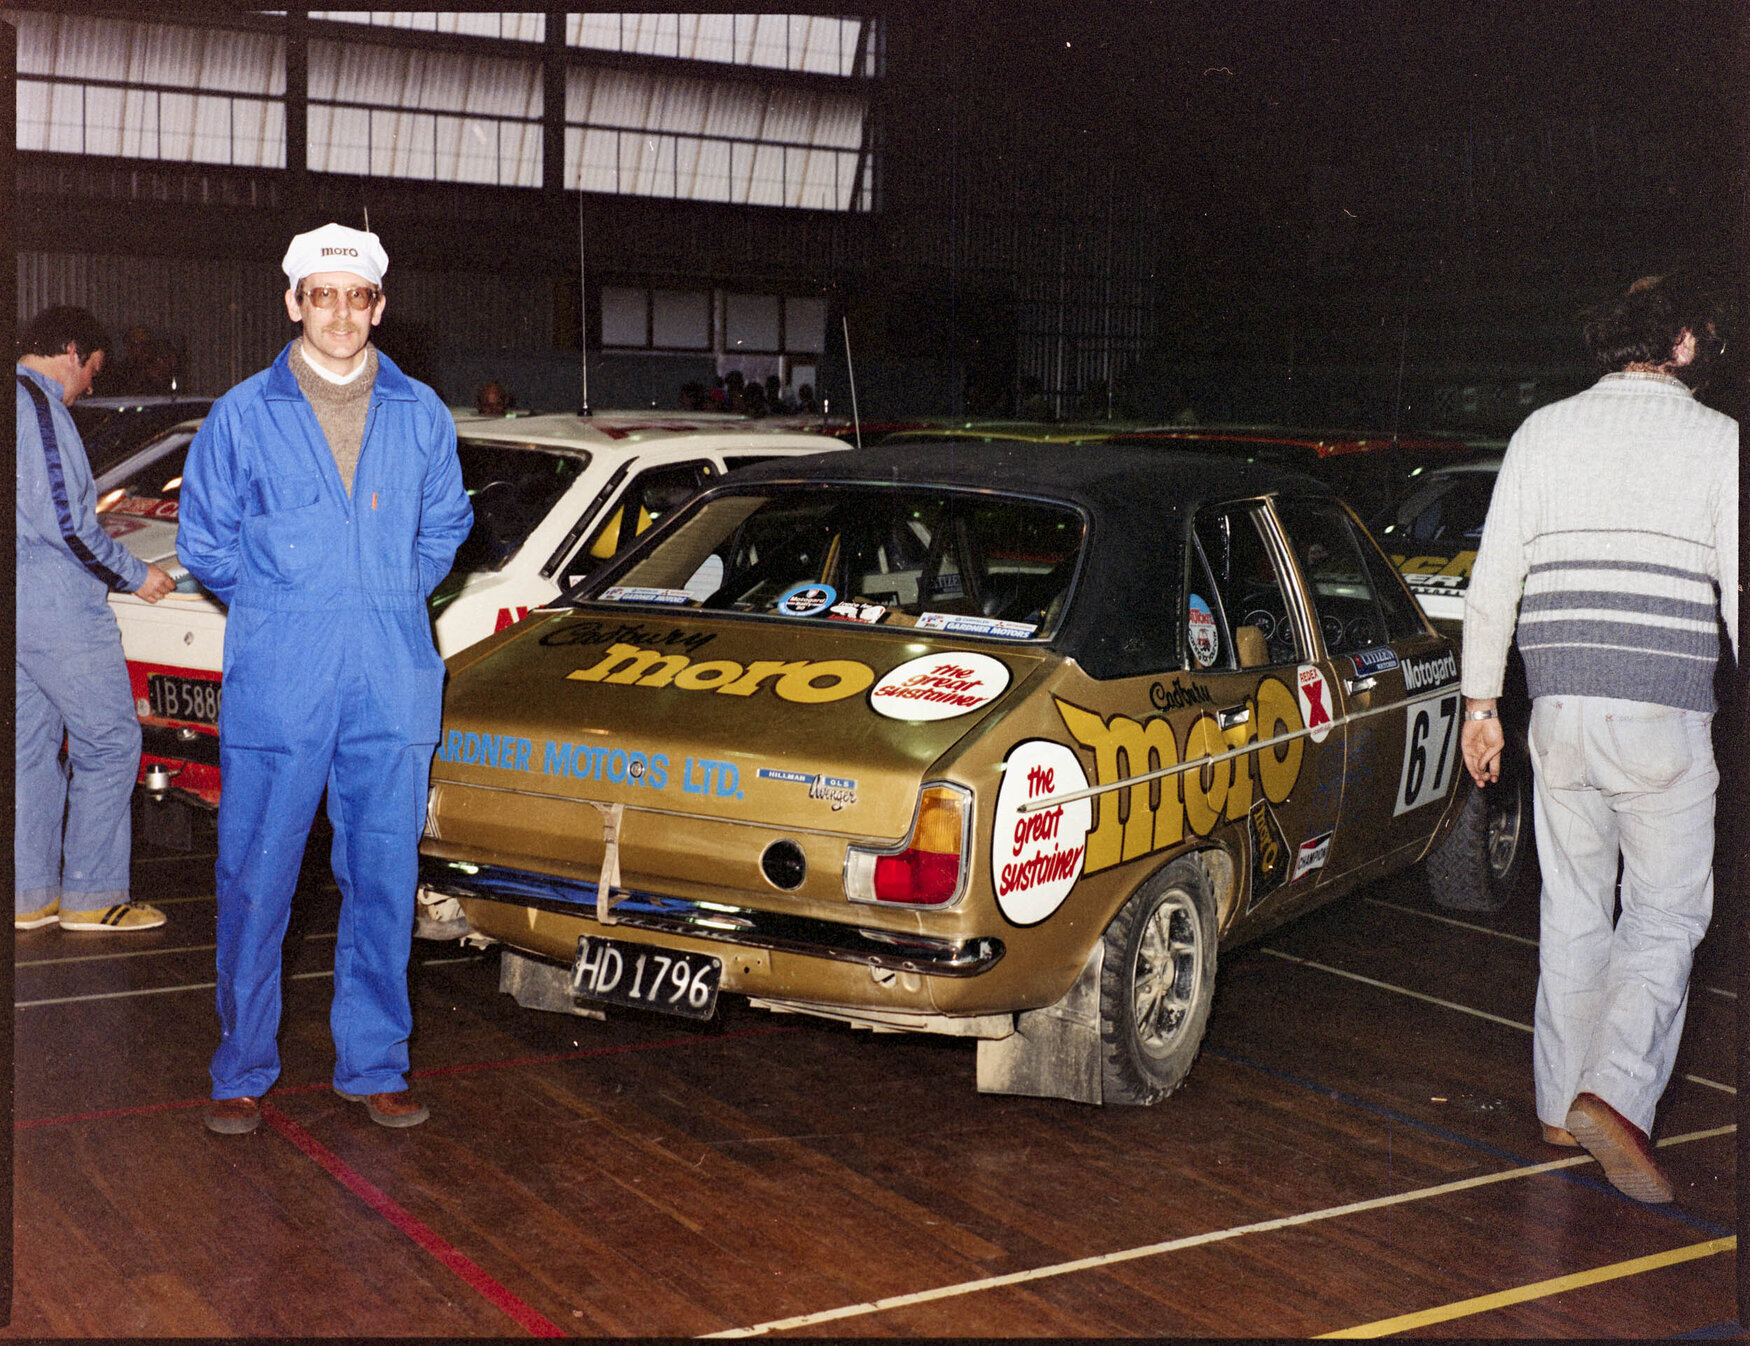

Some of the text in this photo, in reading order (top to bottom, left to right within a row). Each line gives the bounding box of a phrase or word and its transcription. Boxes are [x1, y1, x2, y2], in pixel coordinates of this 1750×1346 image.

[321, 247, 359, 258] moro
[946, 622, 990, 634] GARDNER
[990, 627, 1030, 638] MOTORS
[565, 643, 876, 704] moro
[902, 673, 983, 692] great
[930, 664, 974, 679] the
[1299, 668, 1319, 682] REDEX
[1401, 650, 1457, 690] Motogard
[874, 684, 990, 708] sustainer
[1301, 679, 1330, 728] X
[543, 740, 670, 790] MOTORS
[682, 757, 745, 800] LTD.
[1405, 696, 1457, 806] 67
[769, 771, 806, 781] HILLMAN
[1027, 764, 1055, 799] the
[1051, 676, 1305, 880] moro
[1012, 804, 1064, 857] great
[999, 843, 1084, 897] sustainer
[574, 940, 711, 1008] HD 1796
